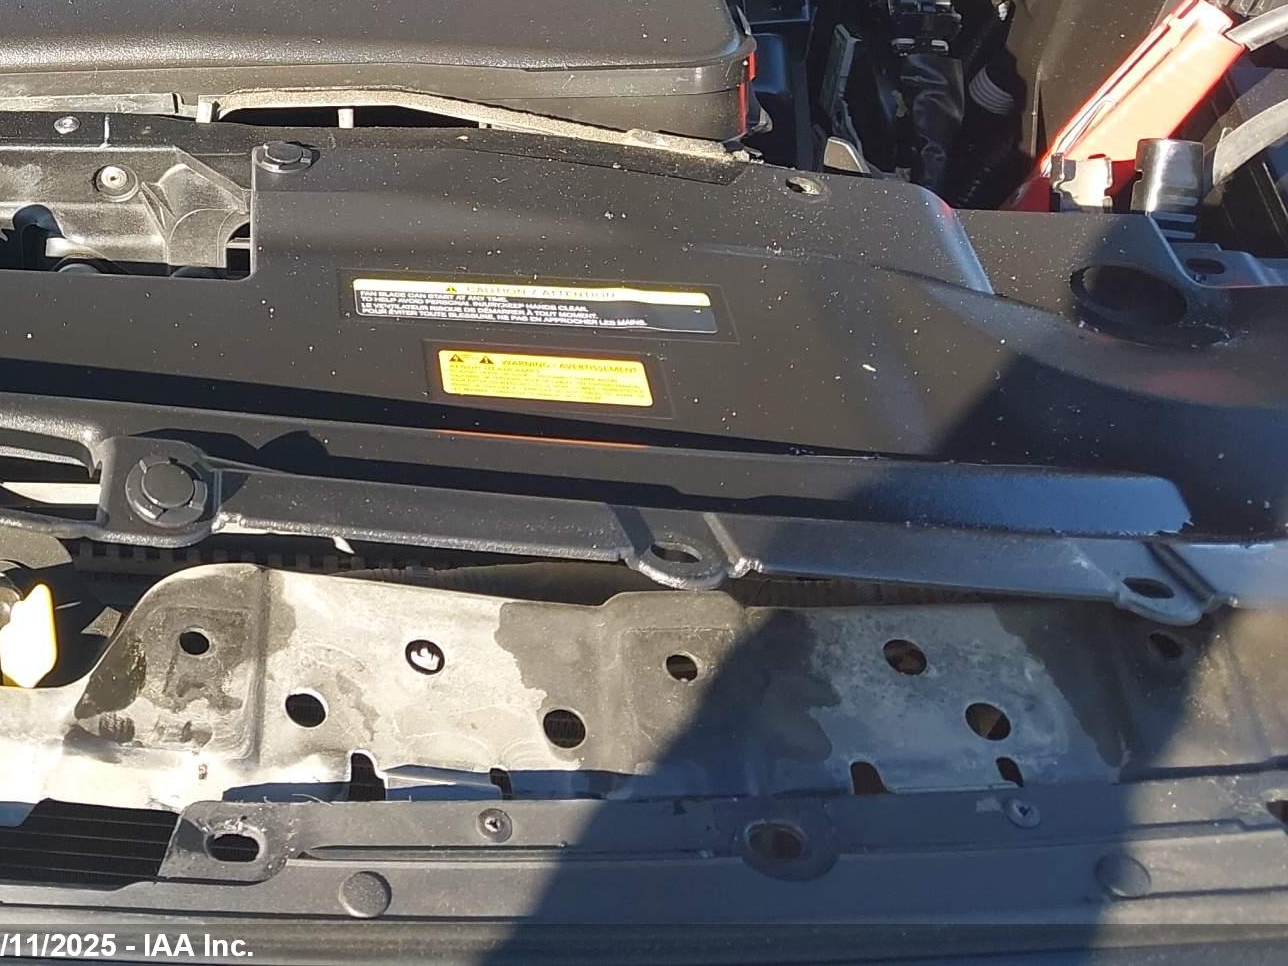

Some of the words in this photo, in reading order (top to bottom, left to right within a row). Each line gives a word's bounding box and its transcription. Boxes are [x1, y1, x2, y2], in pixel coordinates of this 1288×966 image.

[378, 291, 407, 299] BLADE
[425, 299, 469, 307] PERSONAL
[373, 302, 428, 311] VENTILATEUR
[429, 305, 462, 313] RISQUE
[477, 306, 525, 315] DÉMARRER
[558, 311, 599, 319] MOMENT.
[388, 307, 417, 316] ÉVITER
[419, 310, 448, 318] TOUTE
[543, 317, 598, 325] APPROCHER
[599, 318, 616, 326] LES
[502, 360, 550, 369] WARNING
[559, 363, 637, 374] AVERTISSEMENT
